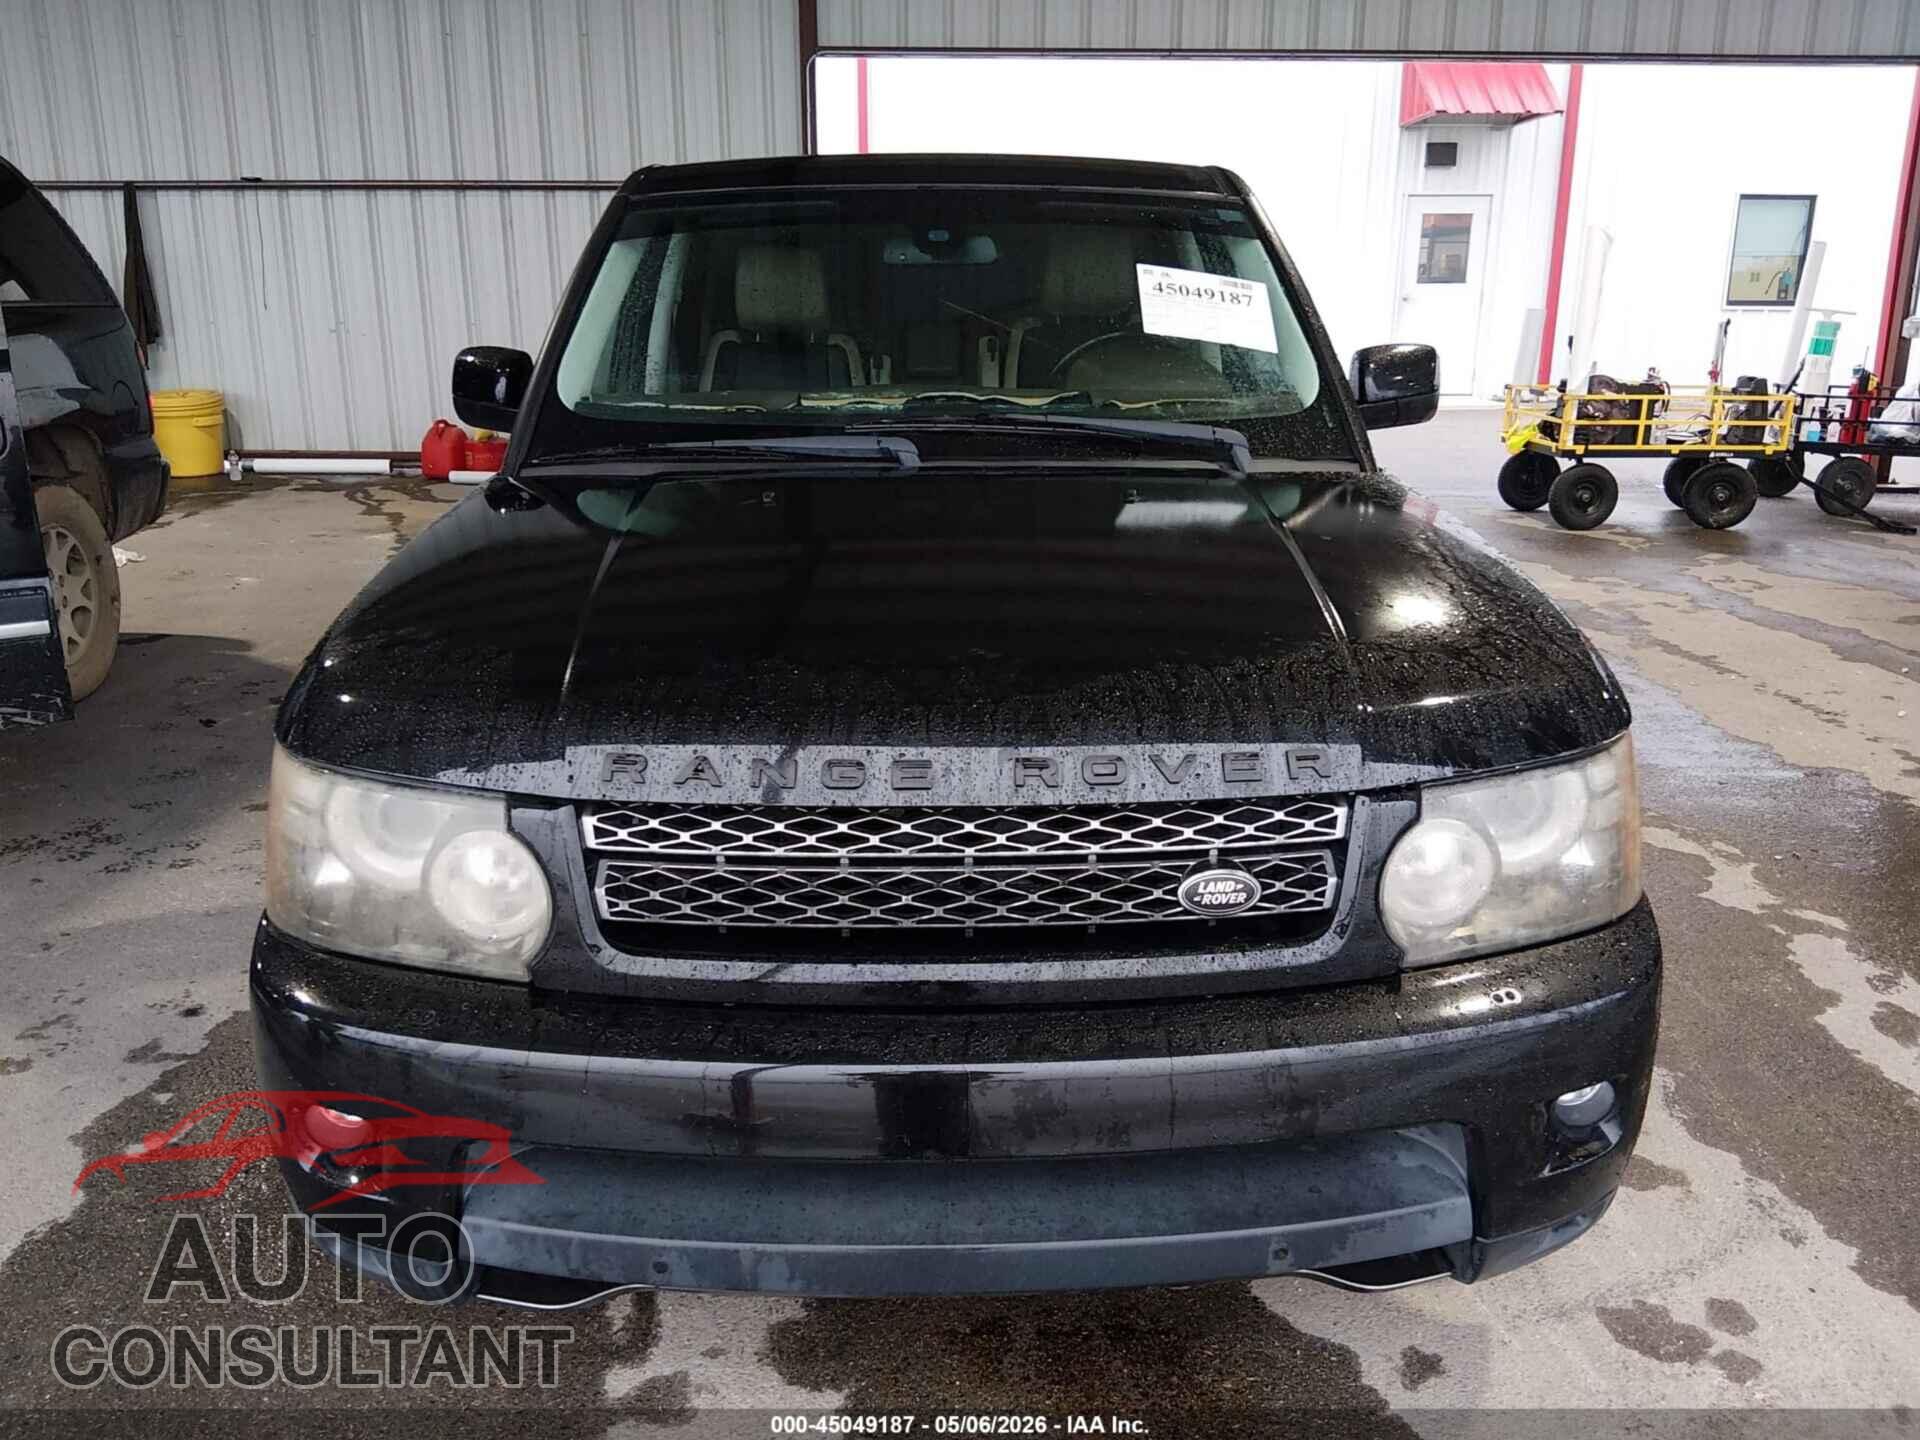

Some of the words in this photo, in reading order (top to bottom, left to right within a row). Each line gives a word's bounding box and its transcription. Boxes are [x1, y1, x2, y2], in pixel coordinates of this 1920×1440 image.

[1152, 281, 1253, 306] 45049187
[601, 752, 933, 790] RANGE
[1010, 750, 1332, 788] ROVER
[1197, 880, 1236, 894] LAND
[1201, 892, 1247, 905] ROVER
